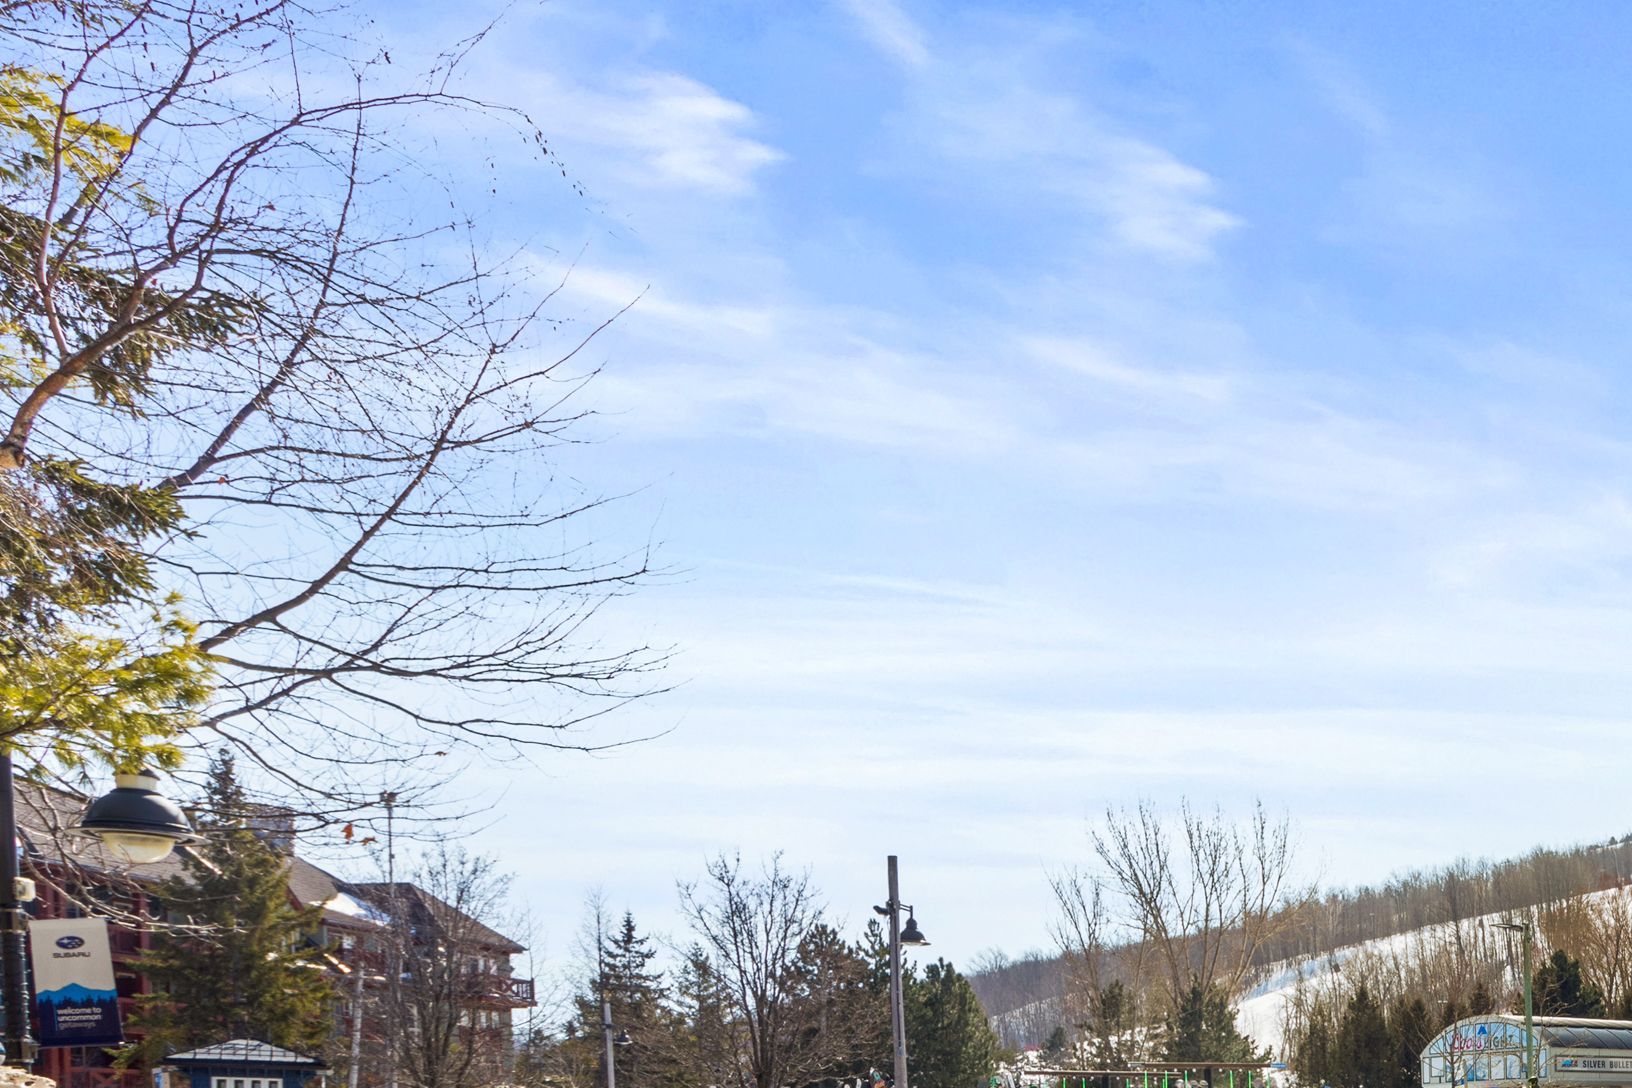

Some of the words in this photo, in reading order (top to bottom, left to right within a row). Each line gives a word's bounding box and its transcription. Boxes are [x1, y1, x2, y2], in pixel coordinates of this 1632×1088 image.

[57, 1006, 91, 1014] welcome
[1582, 1060, 1606, 1068] SILVER
[1609, 1061, 1632, 1069] BULLET
